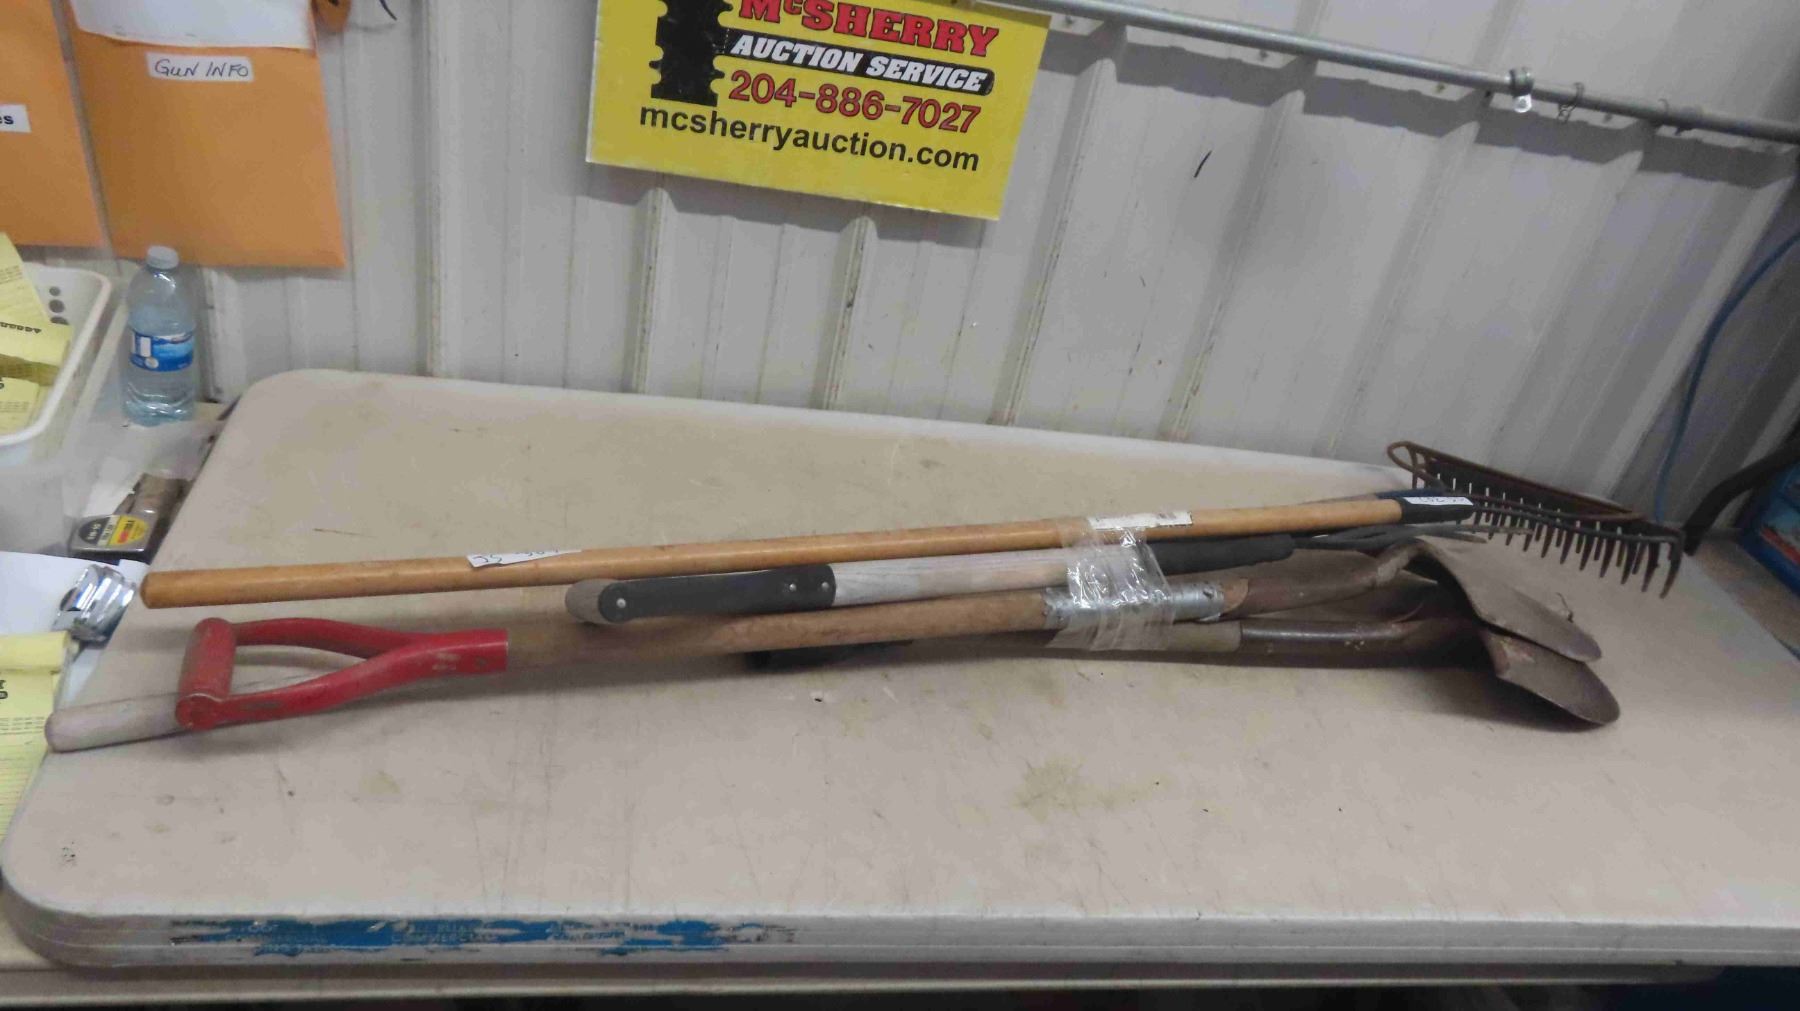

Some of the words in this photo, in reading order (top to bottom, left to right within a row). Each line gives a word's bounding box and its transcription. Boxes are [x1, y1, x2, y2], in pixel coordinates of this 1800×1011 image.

[739, 0, 999, 58] McSHERRY
[205, 61, 249, 77] INFO
[731, 34, 864, 73] AUCTION
[866, 55, 988, 93] SERVICE
[728, 69, 982, 133] 204-886-7027
[639, 106, 980, 172] mcsherryauction.com
